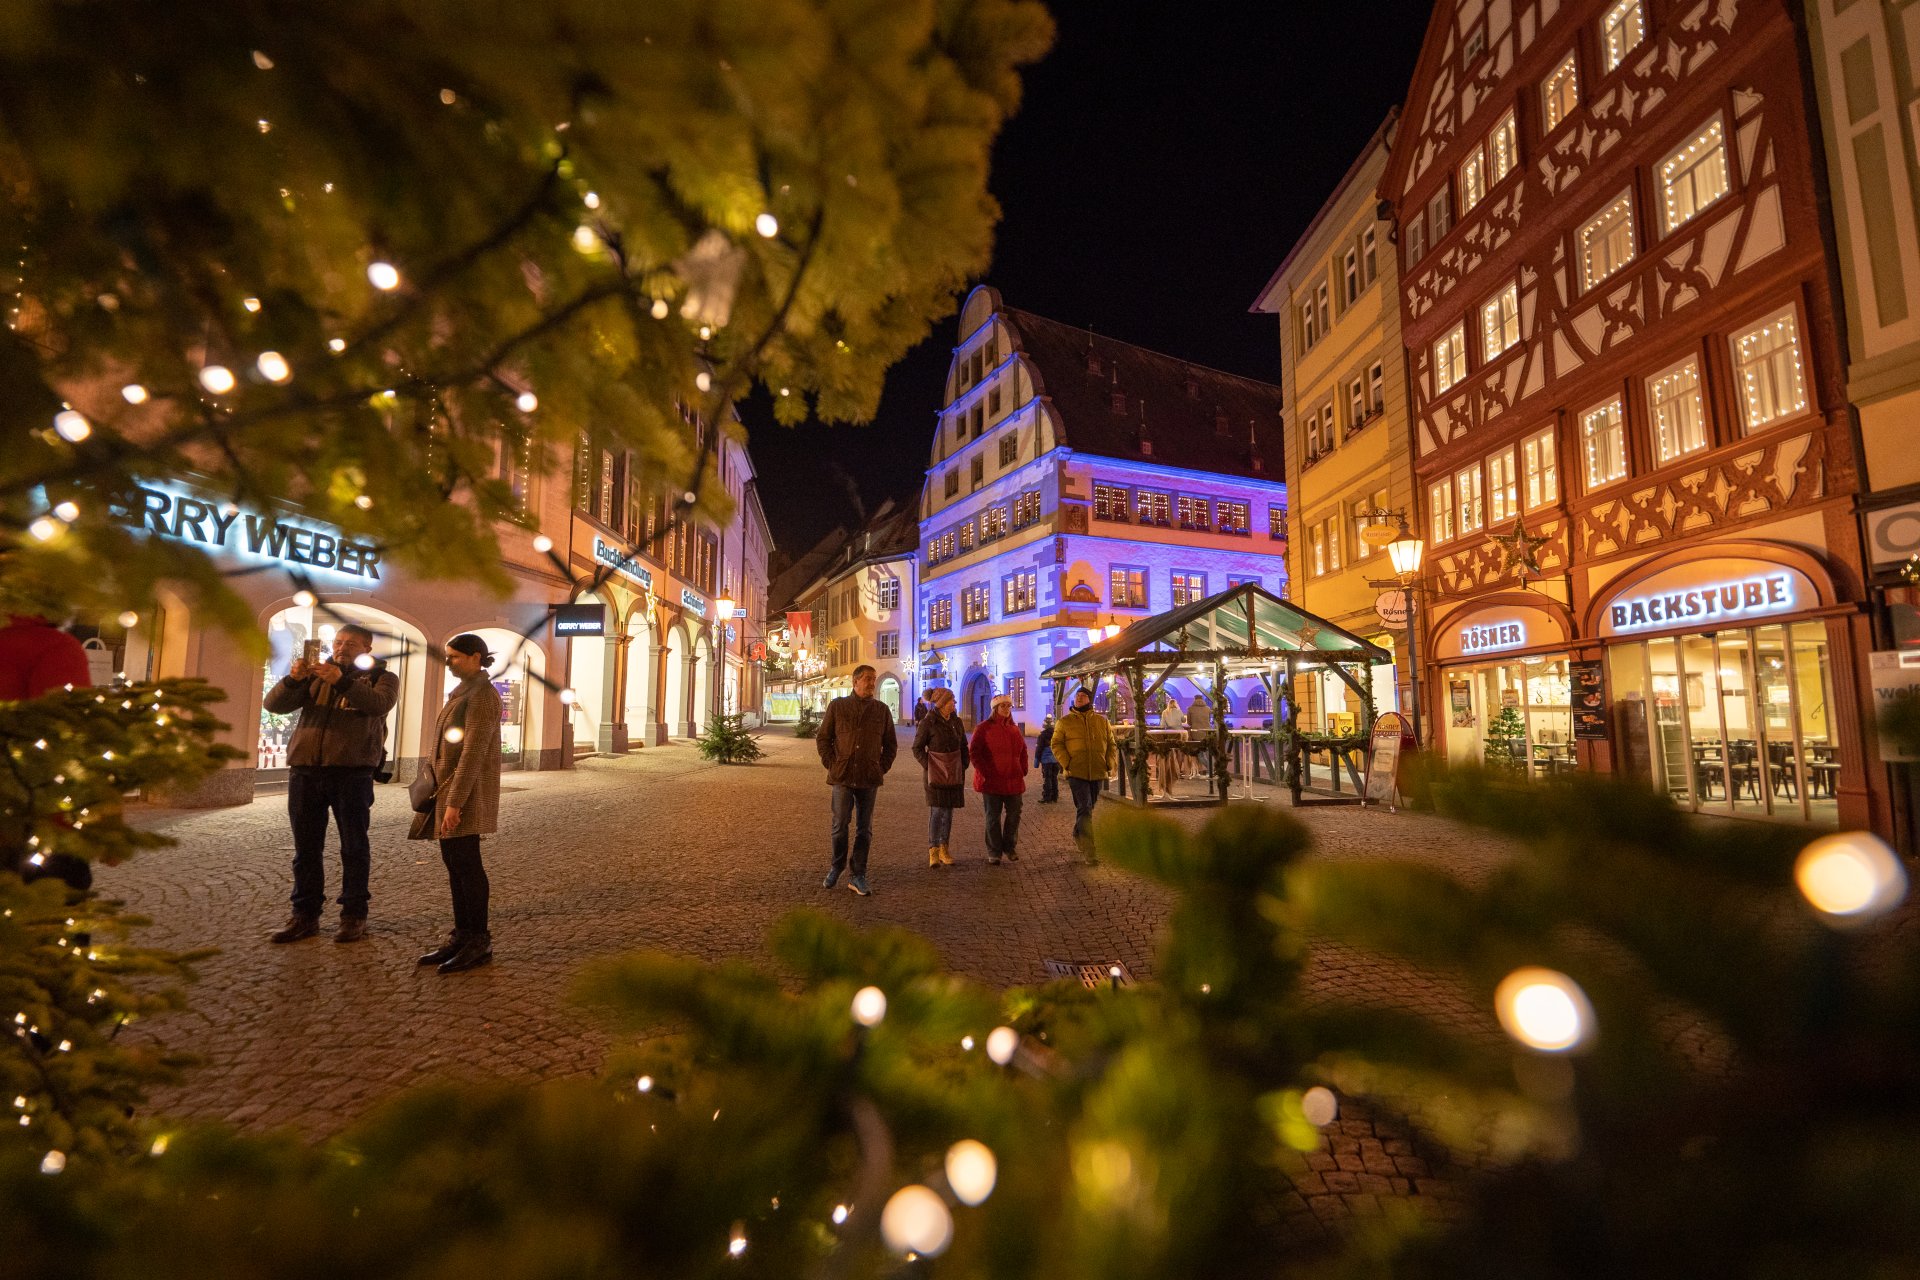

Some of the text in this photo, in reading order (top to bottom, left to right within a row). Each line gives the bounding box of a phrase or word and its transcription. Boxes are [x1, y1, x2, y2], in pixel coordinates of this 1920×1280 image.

[246, 514, 380, 579] WEBER
[597, 539, 652, 587] Buchhandlung
[1382, 608, 1407, 616] Rösne
[1612, 576, 1788, 628] BACKSTUBE
[558, 622, 602, 630] GERRY WEBER
[1460, 623, 1522, 650] RÖSNER
